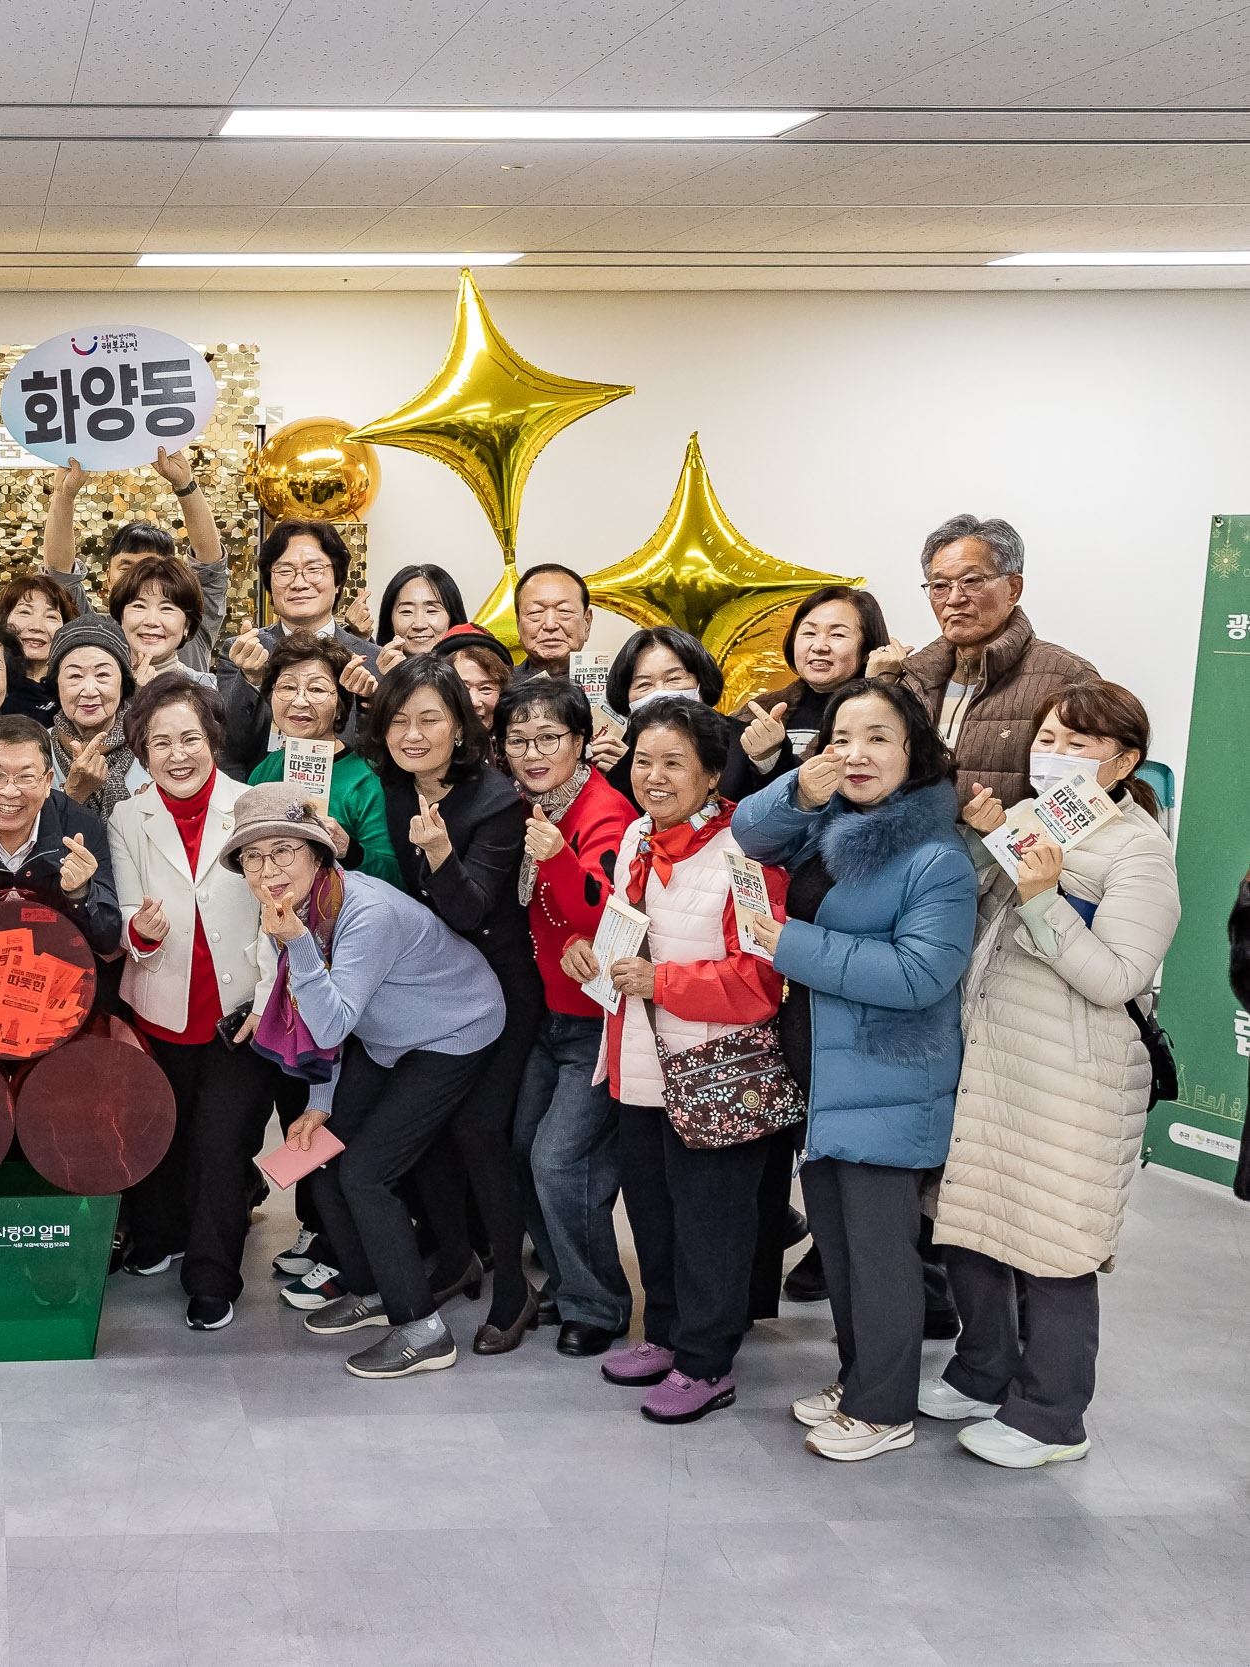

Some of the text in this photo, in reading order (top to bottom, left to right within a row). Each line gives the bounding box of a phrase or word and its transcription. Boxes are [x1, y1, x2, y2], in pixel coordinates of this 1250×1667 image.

[101, 339, 138, 354] 행복광진
[20, 358, 196, 444] 화양동
[1226, 613, 1250, 640] 광
[574, 673, 608, 684] 따뜻한
[289, 760, 327, 774] 따뜻한
[289, 770, 325, 783] 겨울나기
[1063, 784, 1078, 800] 2026
[1044, 797, 1080, 836] 겨울나기
[1052, 788, 1092, 830] 따뜻한
[733, 873, 763, 894] 따뜻한
[7, 974, 46, 993] 따뜻한
[38, 1224, 70, 1241] 열매
